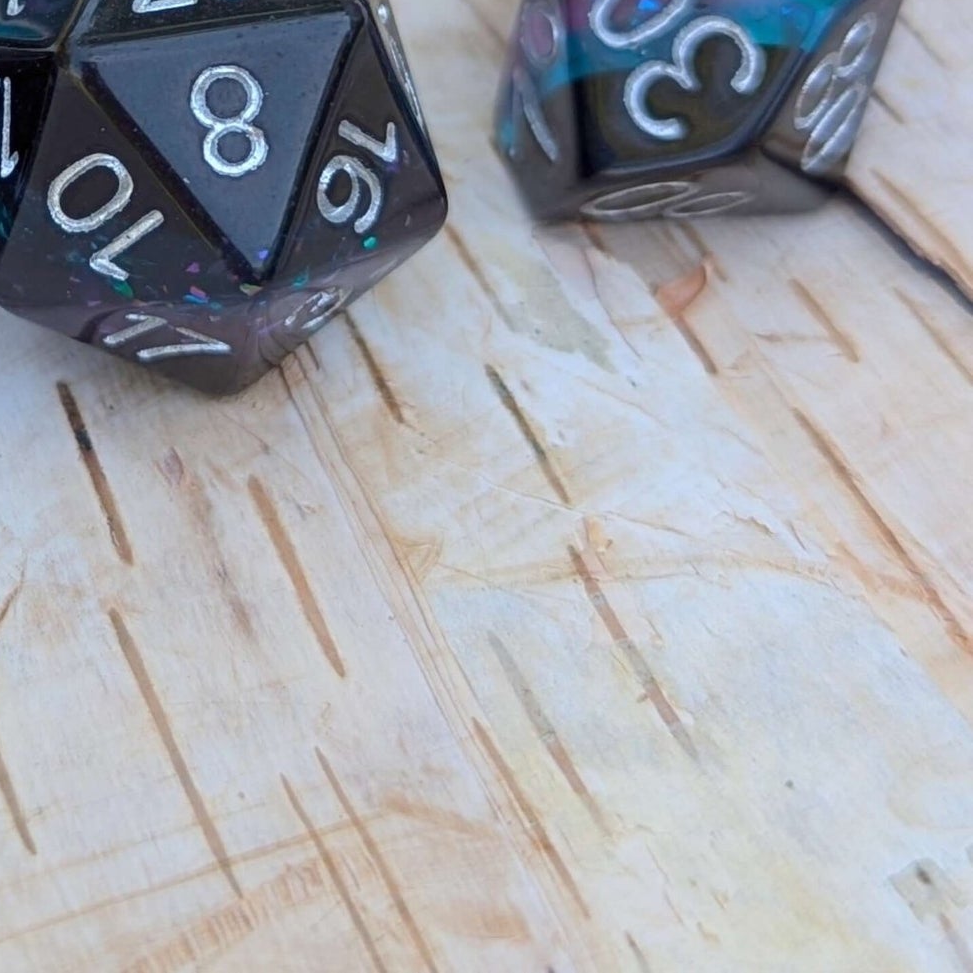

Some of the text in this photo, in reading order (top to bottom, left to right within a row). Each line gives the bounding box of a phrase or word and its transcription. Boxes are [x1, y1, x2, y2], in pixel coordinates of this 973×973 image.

[189, 64, 269, 177] 8
[316, 119, 398, 234] 16
[47, 152, 165, 281] 10
